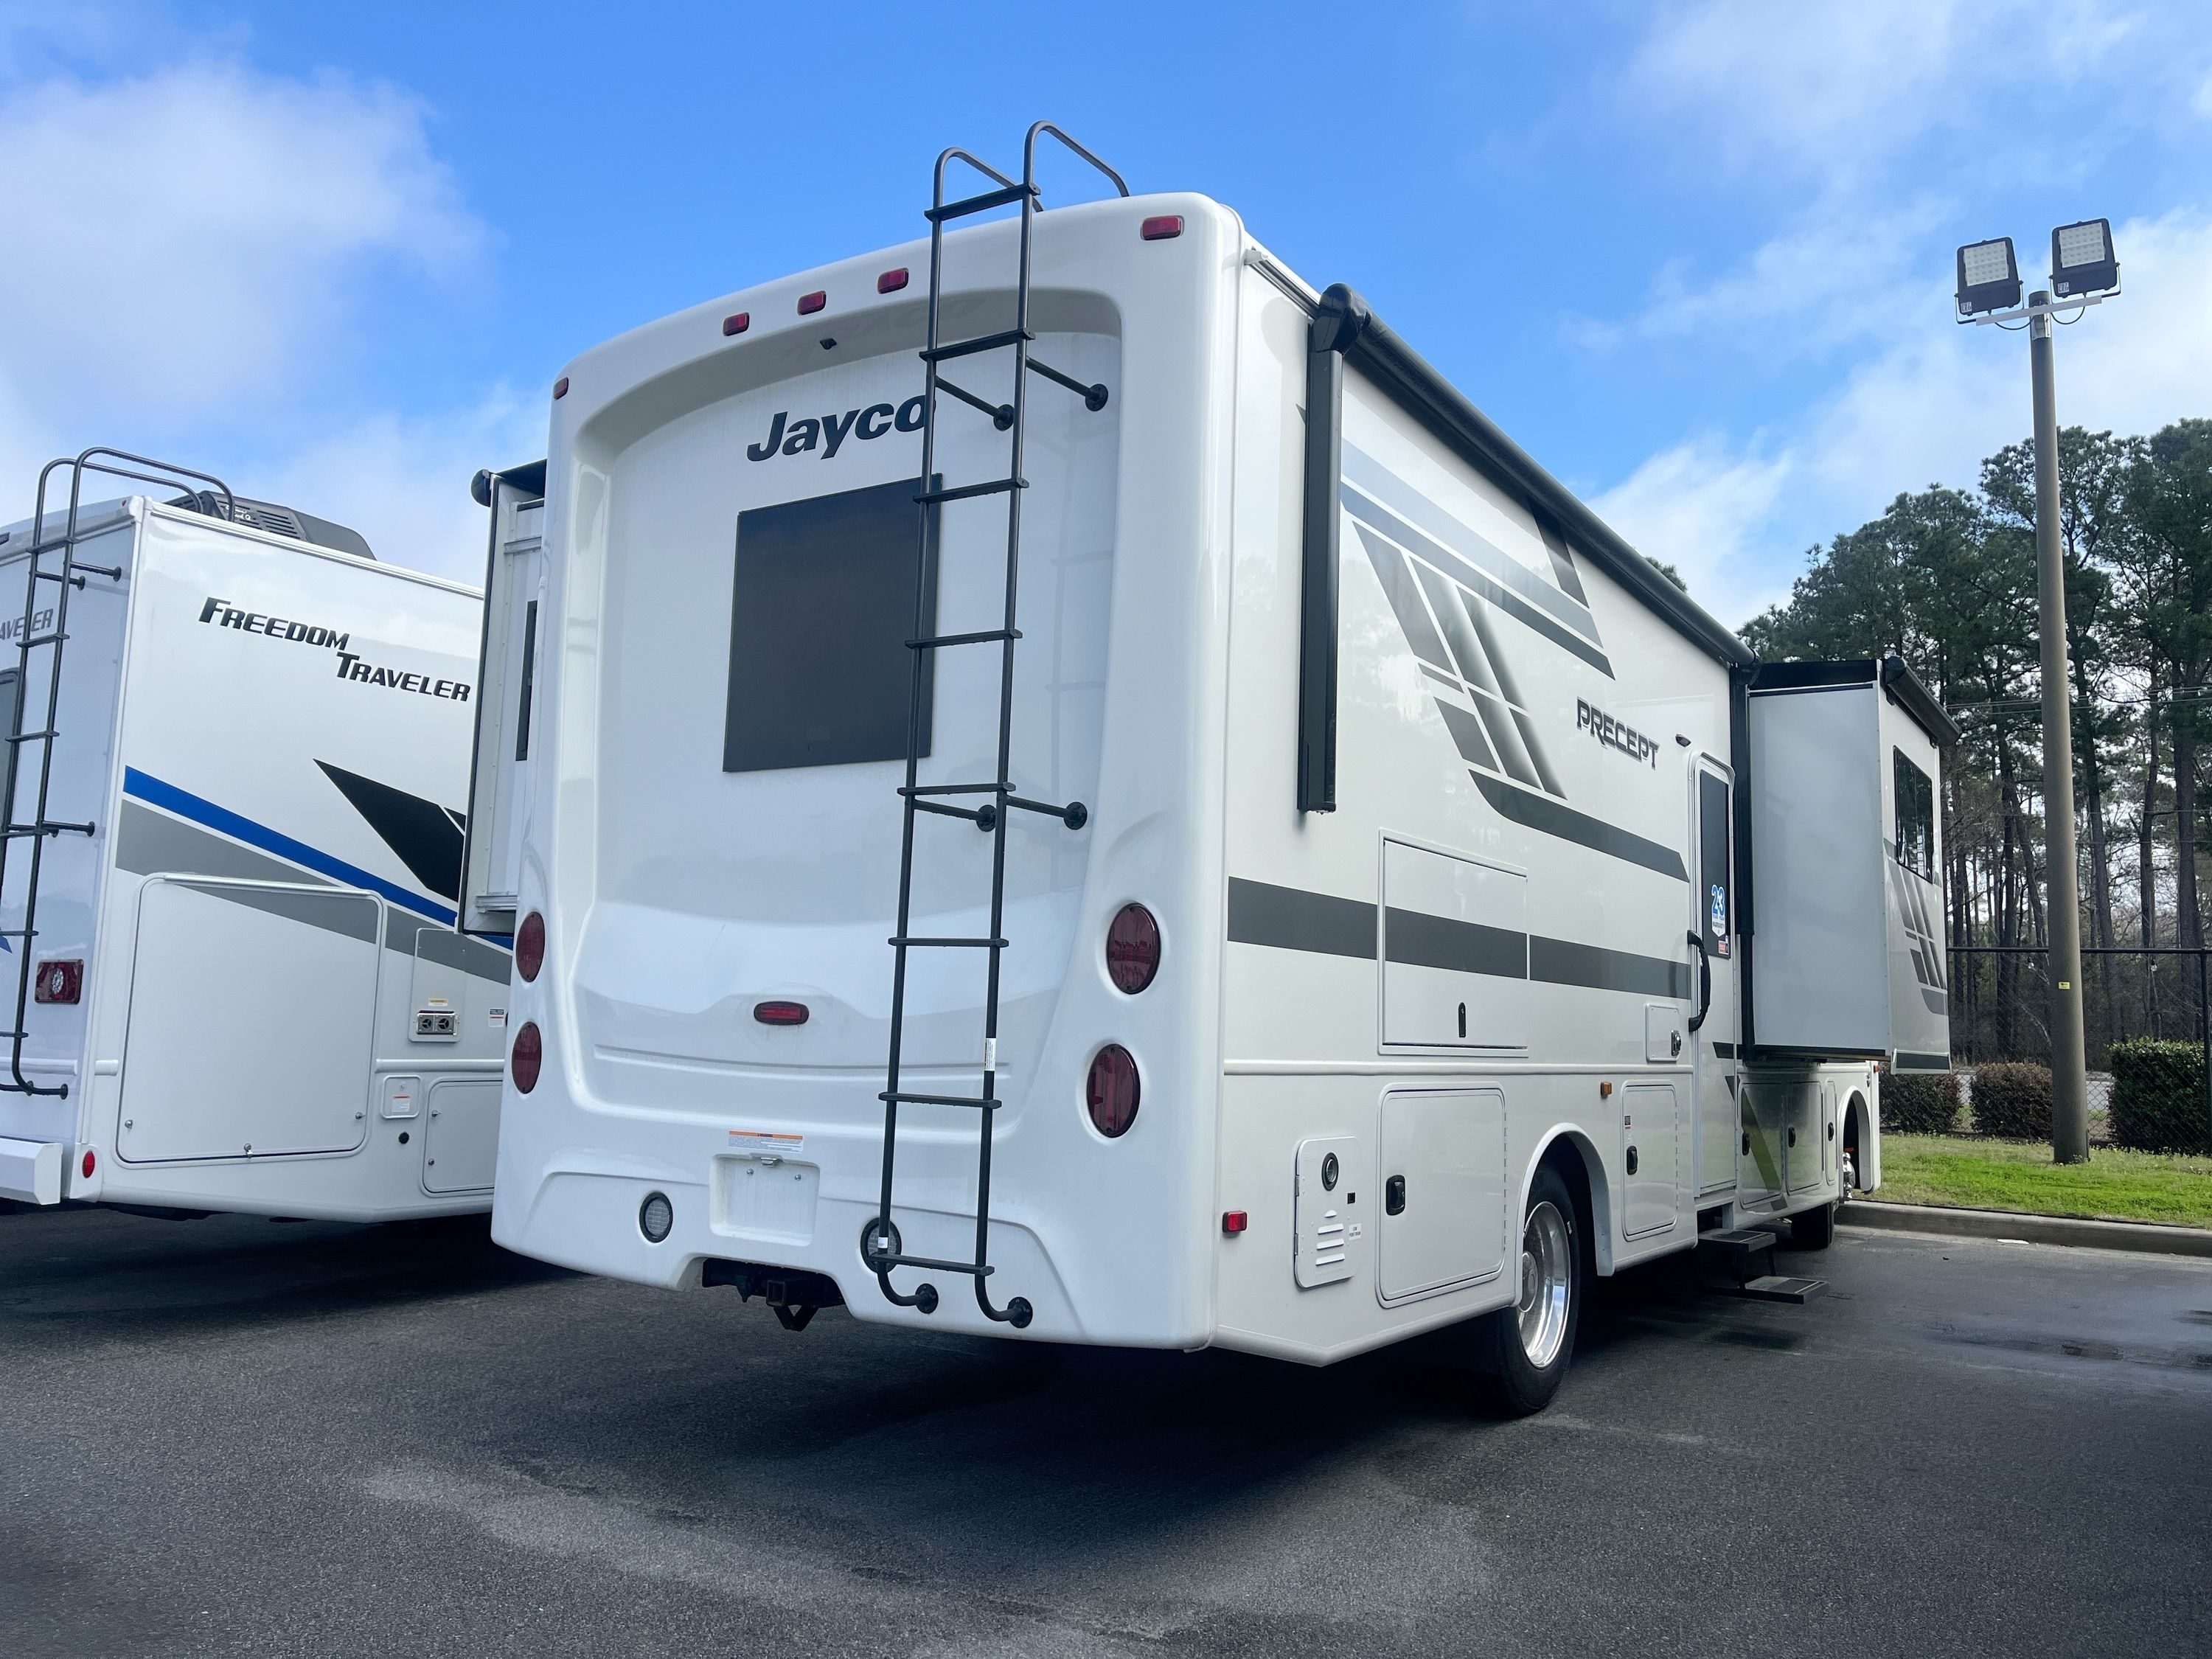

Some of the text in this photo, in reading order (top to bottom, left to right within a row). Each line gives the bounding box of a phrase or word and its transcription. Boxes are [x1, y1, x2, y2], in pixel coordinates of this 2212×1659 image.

[747, 395, 936, 462] Jayco
[0, 608, 54, 640] AVEER
[198, 597, 349, 650] FREEDOM
[336, 651, 471, 702] TRAVELER
[1576, 696, 1660, 771] PRECEPT
